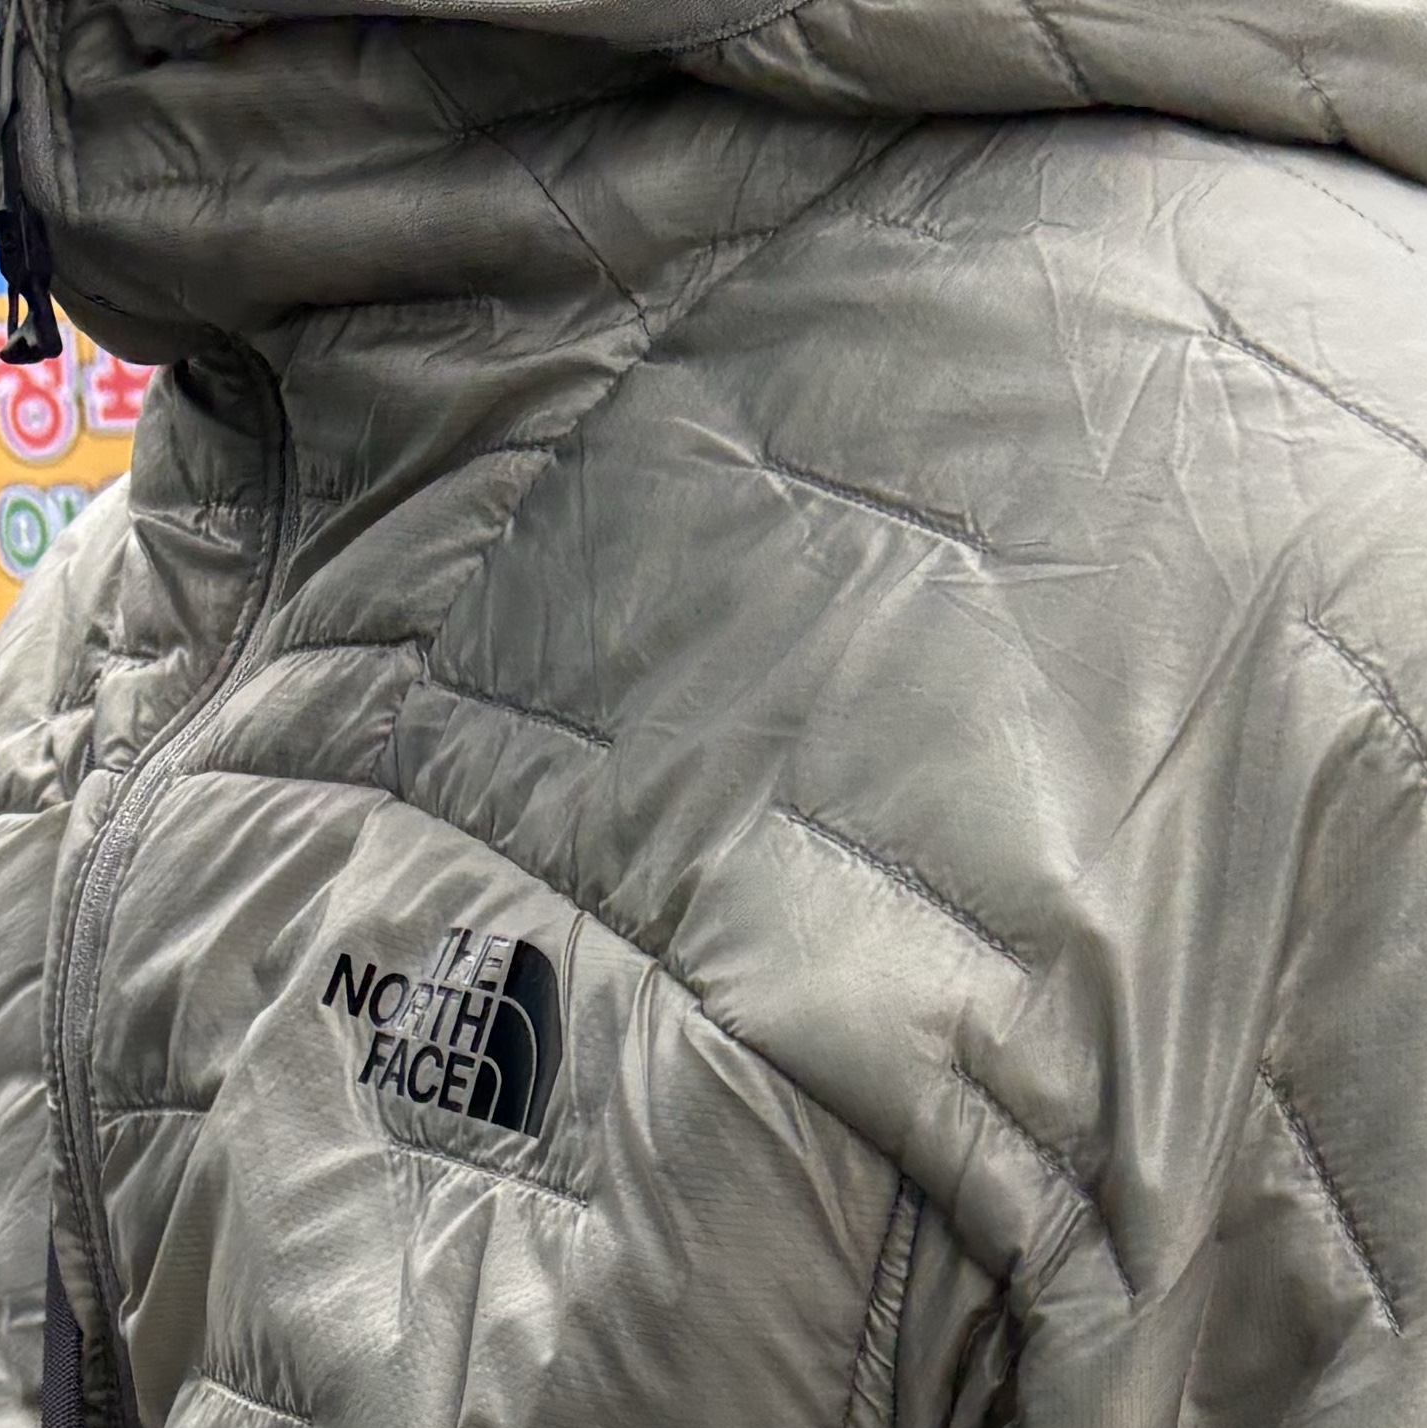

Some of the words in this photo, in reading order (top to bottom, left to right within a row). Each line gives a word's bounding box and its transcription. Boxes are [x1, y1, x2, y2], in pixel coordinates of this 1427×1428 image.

[432, 927, 513, 992] THE
[322, 953, 494, 1053] NORTH
[358, 1032, 476, 1113] FACE
